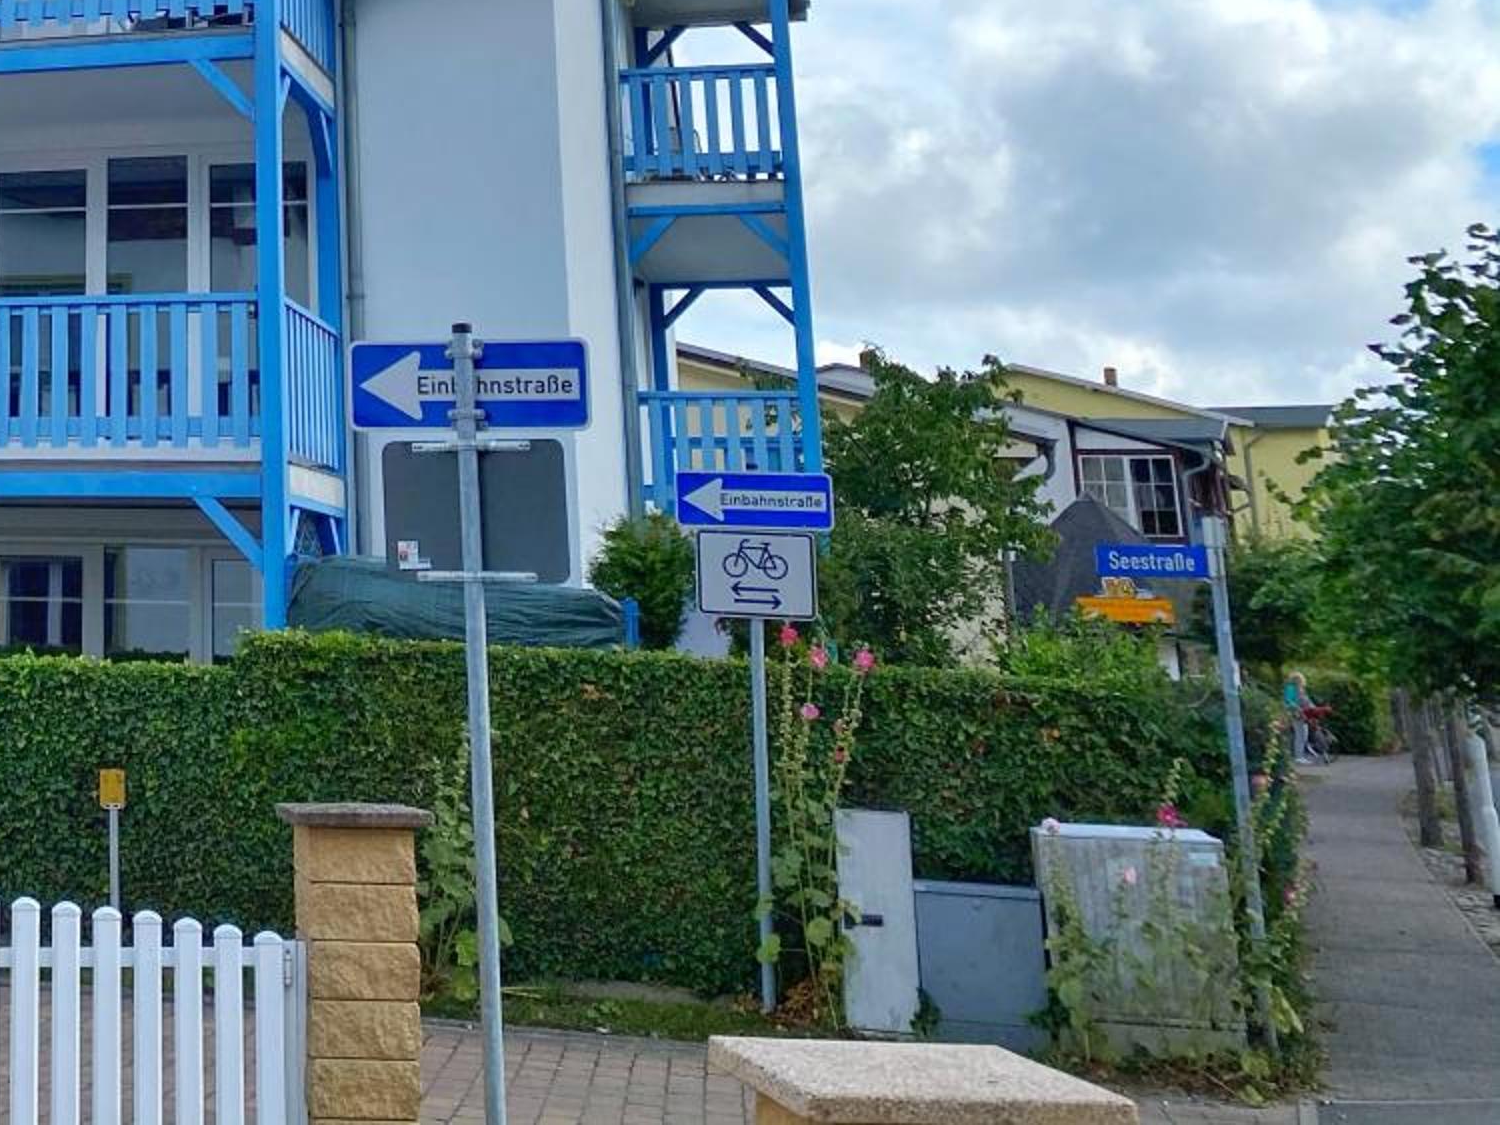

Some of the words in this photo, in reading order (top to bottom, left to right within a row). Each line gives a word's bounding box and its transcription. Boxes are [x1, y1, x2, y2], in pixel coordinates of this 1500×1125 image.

[417, 375, 573, 395] Einhnstraße
[720, 493, 822, 508] Einbahnstraße
[1108, 551, 1196, 571] Seestraße
